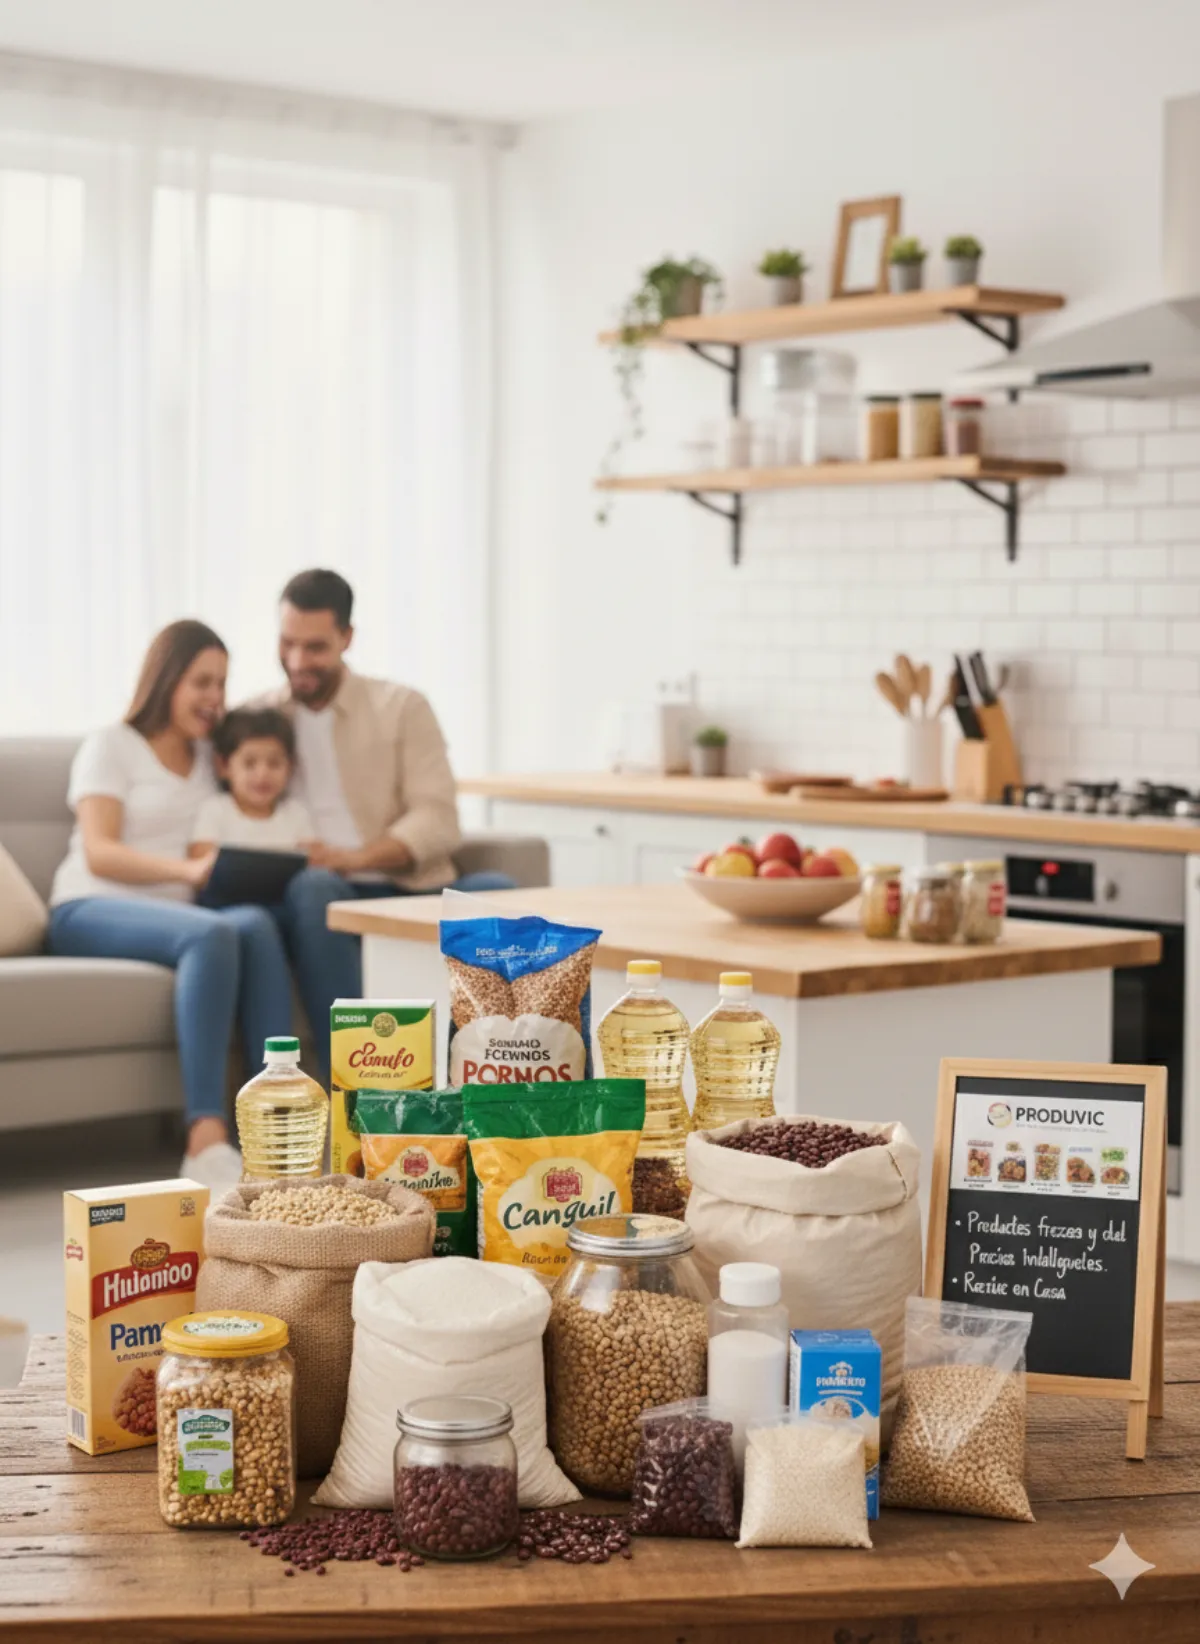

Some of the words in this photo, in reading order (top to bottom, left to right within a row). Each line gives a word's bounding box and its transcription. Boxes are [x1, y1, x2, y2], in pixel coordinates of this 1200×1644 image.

[1015, 1107, 1105, 1126] PRODUVIC
[503, 1191, 616, 1230] Canguil
[1087, 1228, 1097, 1252] y
[1012, 1283, 1030, 1298] en
